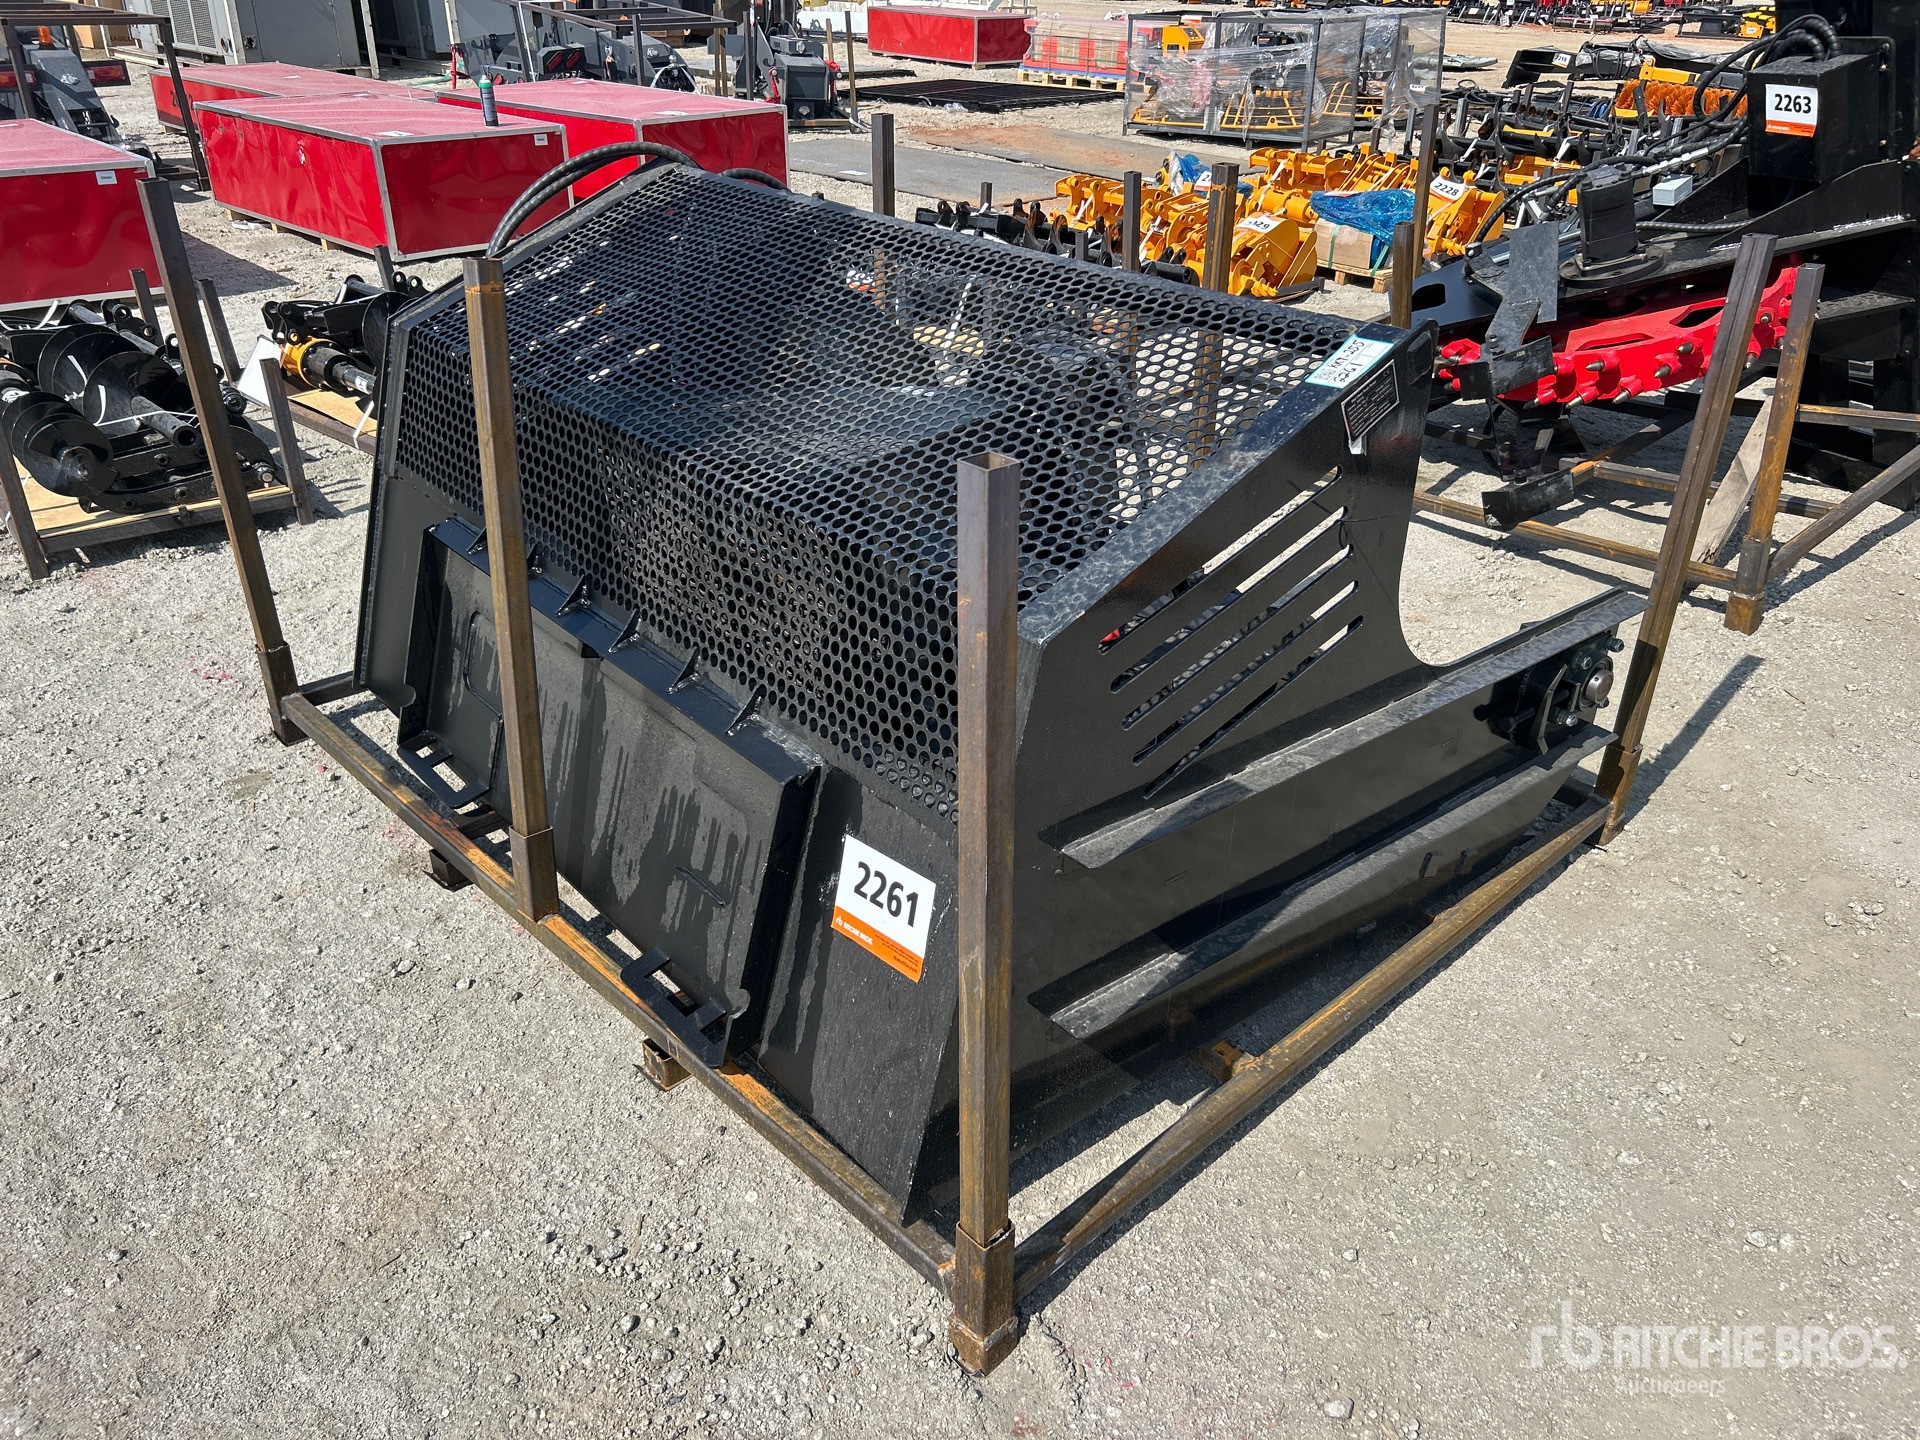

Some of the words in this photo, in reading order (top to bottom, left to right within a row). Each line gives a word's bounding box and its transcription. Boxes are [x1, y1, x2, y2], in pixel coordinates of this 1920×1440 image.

[1774, 93, 1812, 114] 2263
[1434, 182, 1460, 197] 2228
[1333, 362, 1363, 383] 2261
[853, 861, 919, 928] 2261
